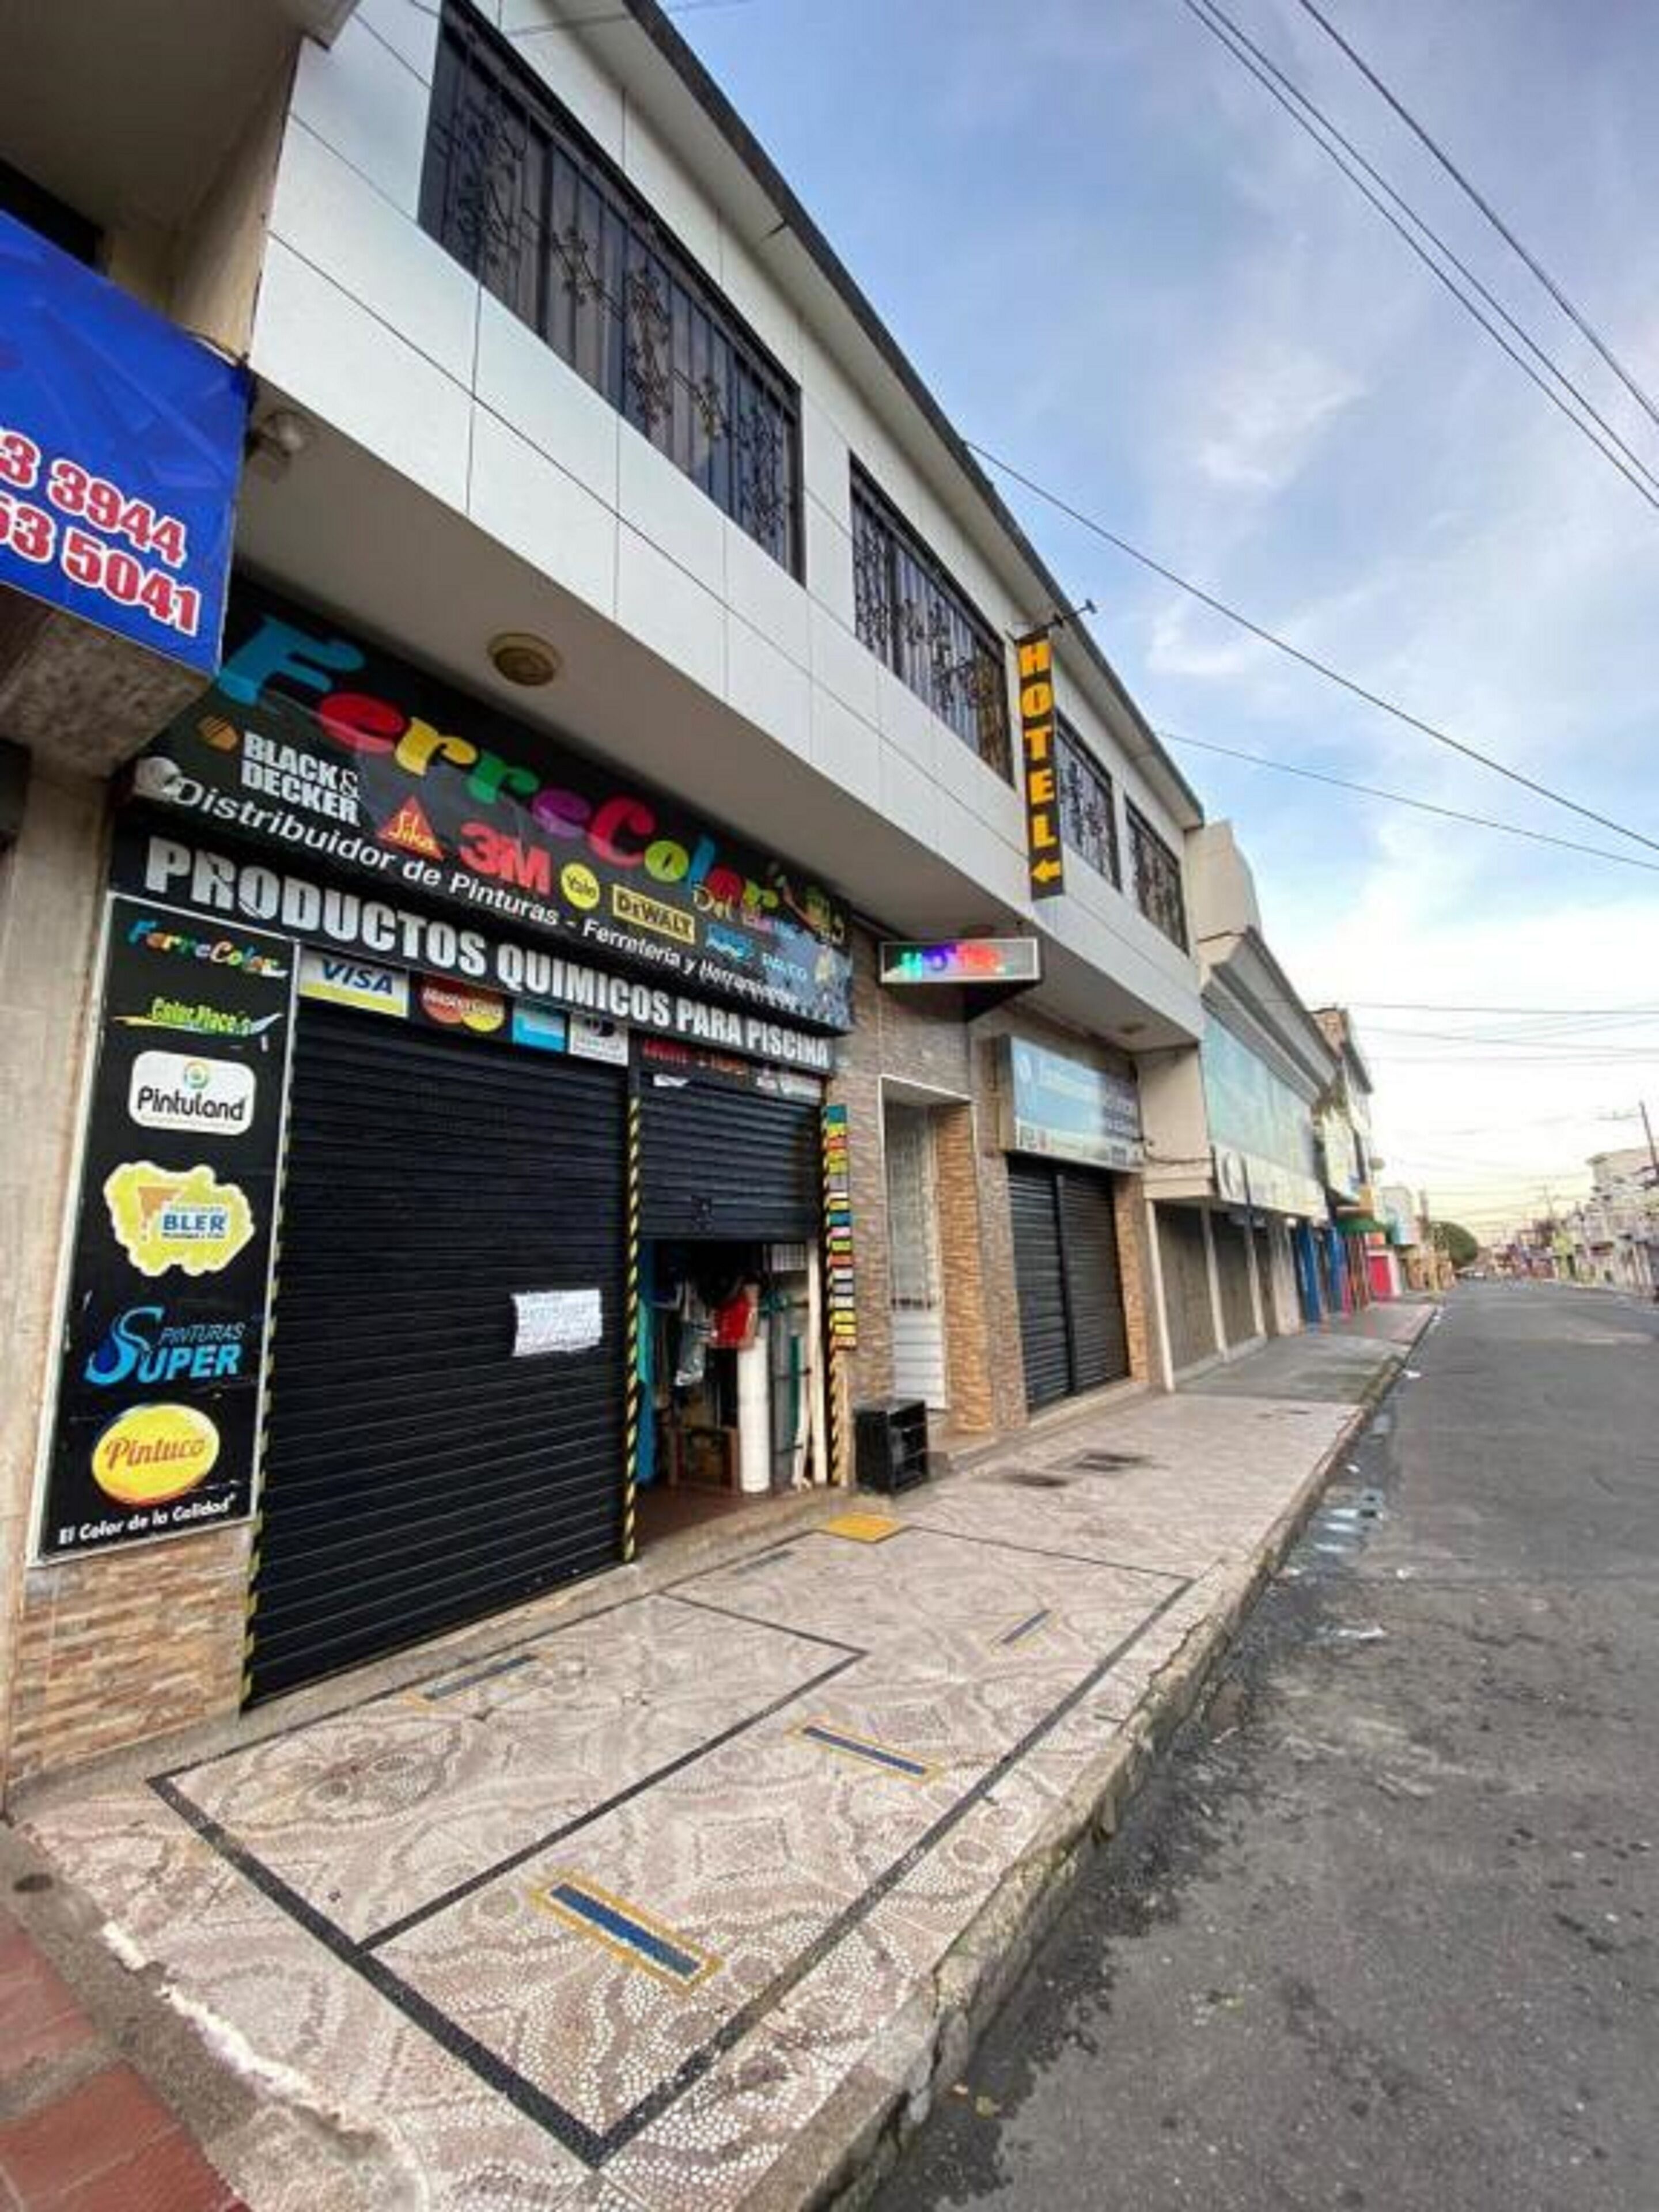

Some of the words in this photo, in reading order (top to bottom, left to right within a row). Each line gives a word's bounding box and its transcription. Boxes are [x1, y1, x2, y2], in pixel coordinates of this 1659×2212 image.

[48, 459, 185, 567] 3944
[61, 527, 200, 636] 5041
[1019, 641, 1056, 849] HOTEL
[241, 759, 362, 828] DECKER
[167, 777, 395, 869] Distribuidor
[403, 859, 442, 886] de
[449, 872, 559, 926] Pinturas
[683, 956, 696, 975] y
[459, 822, 551, 894] 3M
[145, 836, 486, 978] PRODUCTOS
[497, 943, 671, 1028] QUIMICOS
[676, 997, 743, 1046] PARA
[748, 1019, 829, 1069] PISCINA
[322, 959, 393, 995] VISA
[138, 1086, 245, 1121] Pintuland
[164, 1214, 226, 1232] BLER
[85, 1306, 241, 1384] SUPER
[158, 1322, 246, 1346] PINTURAS
[104, 1437, 206, 1471] Pintuco
[59, 1527, 75, 1545] El
[79, 1521, 124, 1540] Color
[128, 1514, 150, 1531] de
[152, 1509, 168, 1525] la
